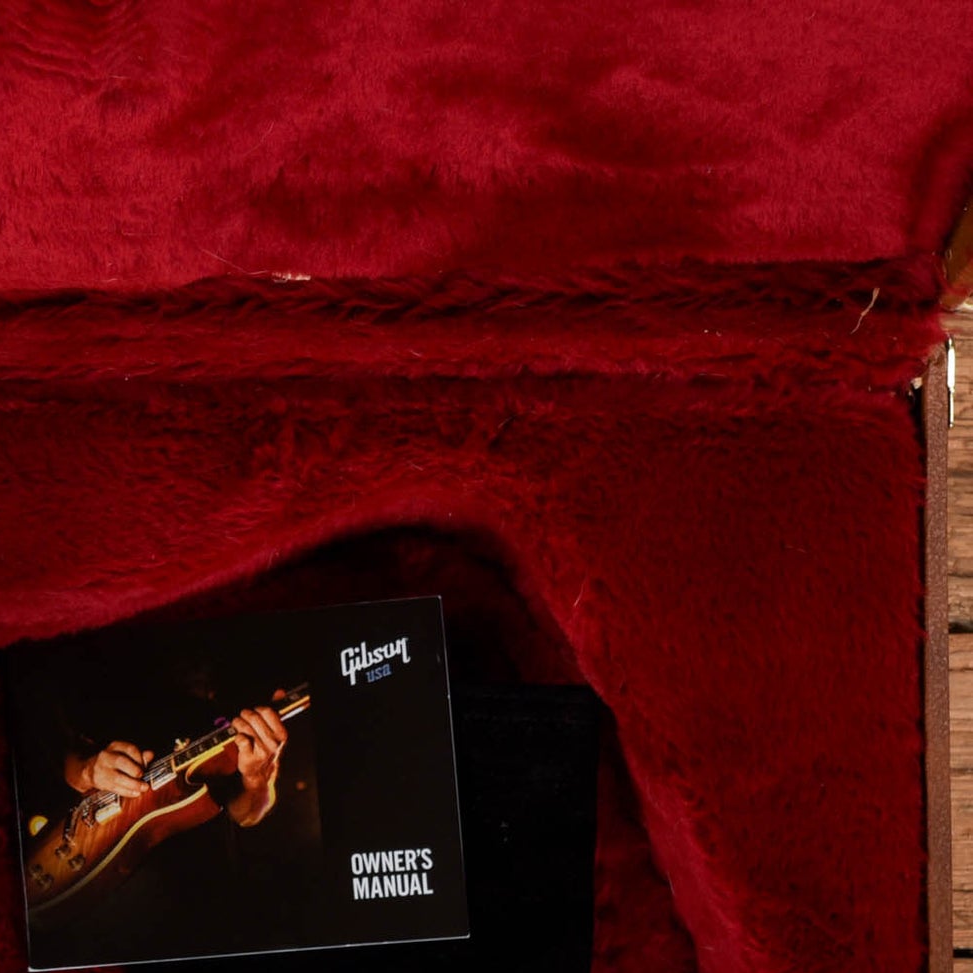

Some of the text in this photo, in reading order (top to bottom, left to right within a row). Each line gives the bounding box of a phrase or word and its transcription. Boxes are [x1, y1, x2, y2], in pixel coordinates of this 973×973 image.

[340, 637, 411, 686] Gibson
[366, 663, 392, 683] usa
[350, 848, 434, 876] OWNER'S
[352, 872, 434, 900] MANUAL
